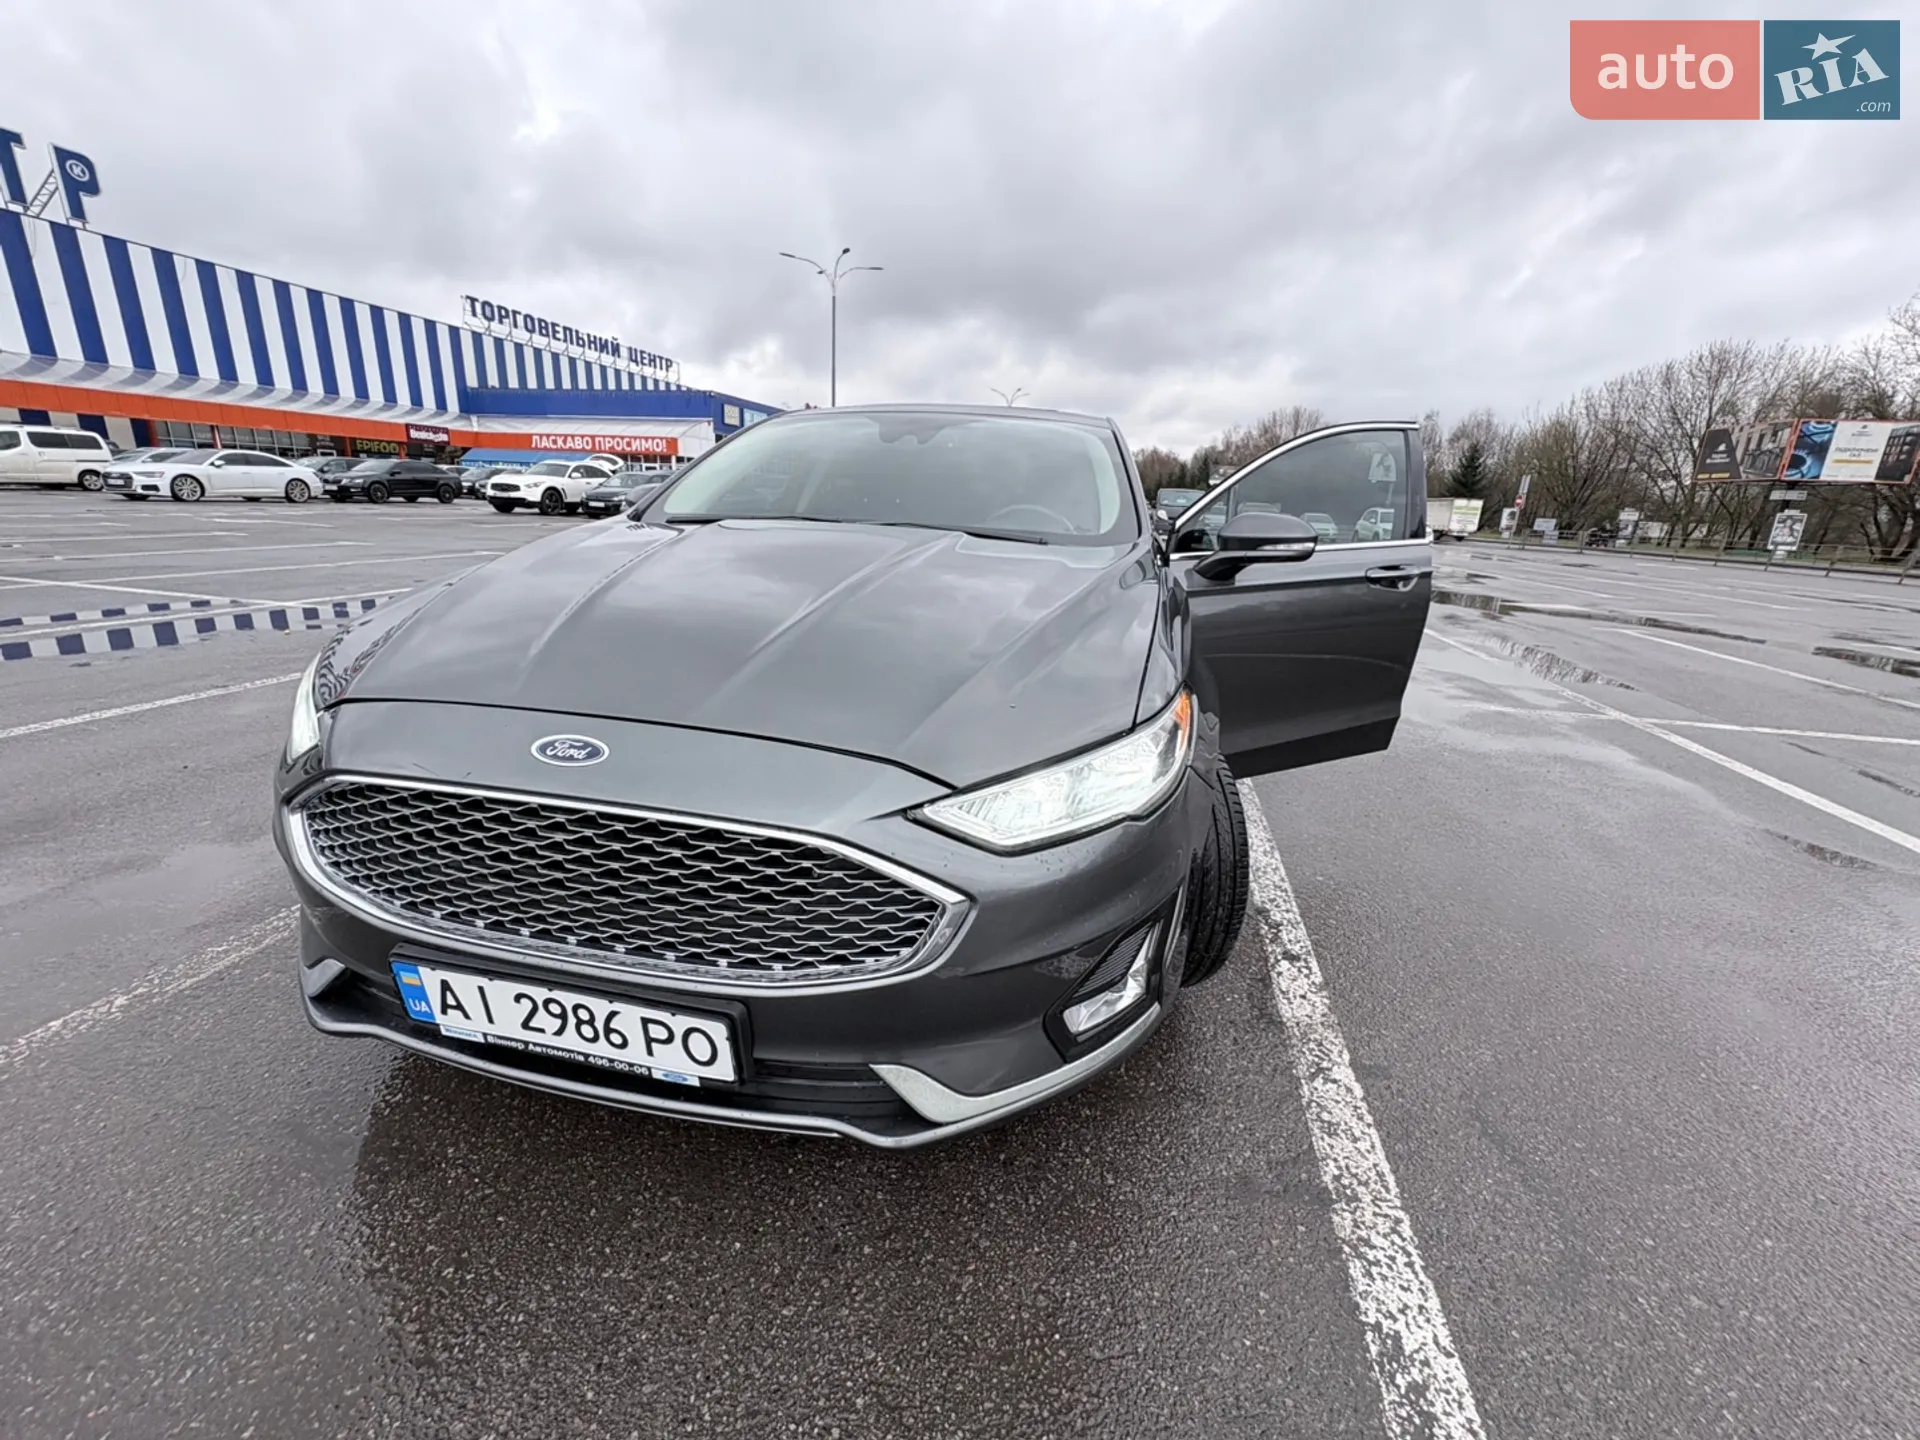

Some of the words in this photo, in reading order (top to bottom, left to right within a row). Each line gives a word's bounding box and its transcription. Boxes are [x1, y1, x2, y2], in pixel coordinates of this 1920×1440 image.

[465, 295, 621, 359] ТОРГОВЕЛЬНИЙ
[627, 346, 673, 373] ЦЕНТР
[531, 435, 592, 450] ЛАСКАВО
[595, 436, 667, 452] ПРОСИМО!
[546, 740, 592, 760] Ford
[410, 999, 431, 1014] UA
[439, 978, 495, 1025] AI
[513, 992, 630, 1050] 2986
[640, 1016, 719, 1067] PO
[588, 1055, 650, 1076] 496-00-06
